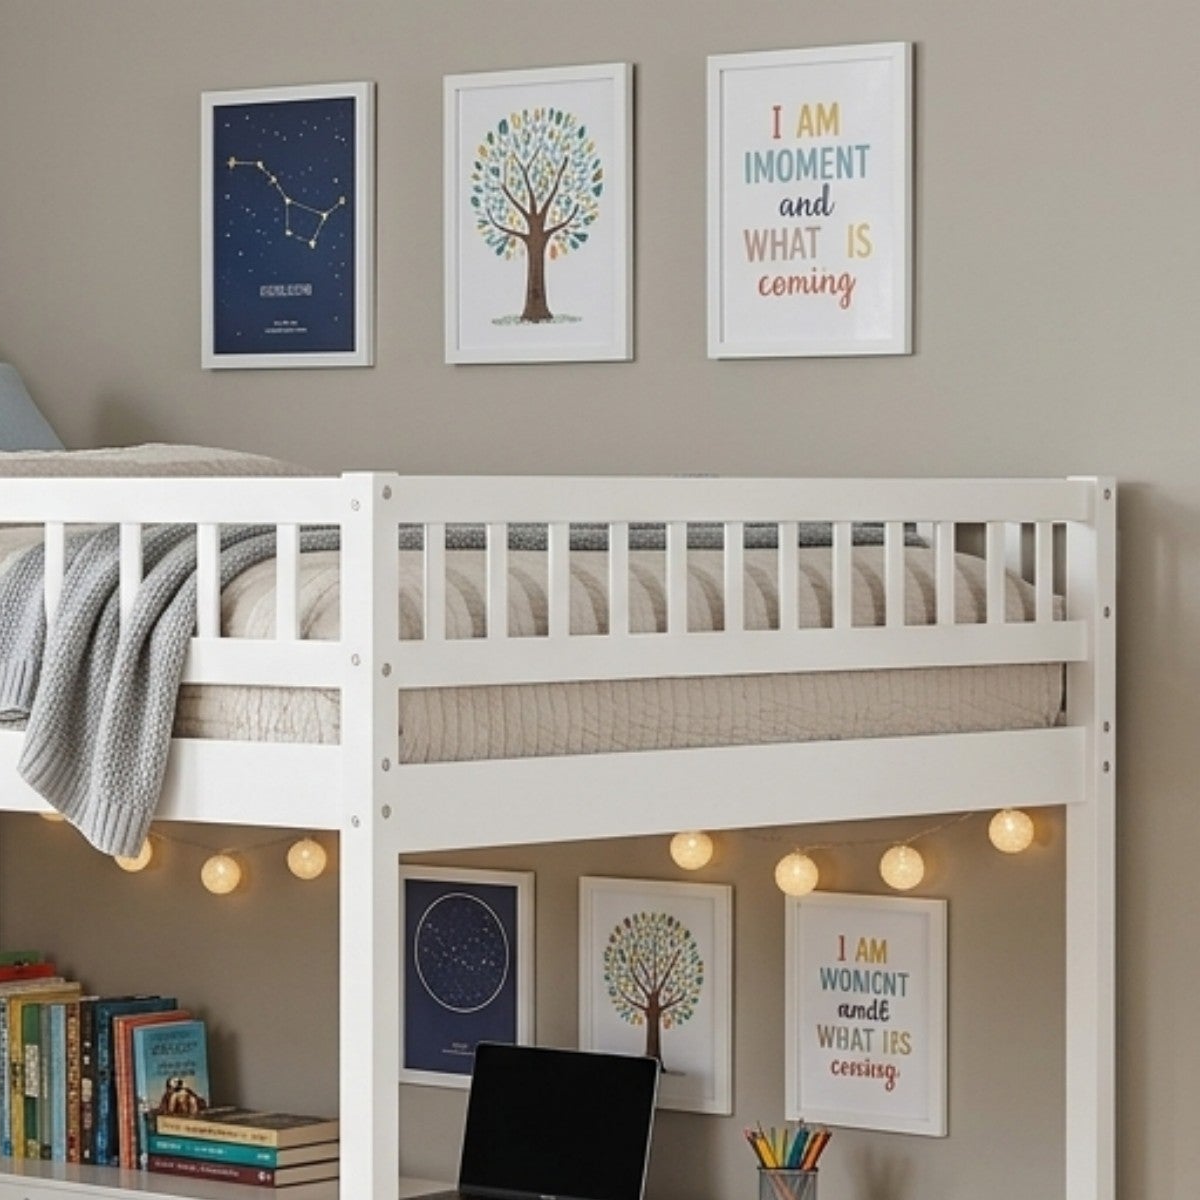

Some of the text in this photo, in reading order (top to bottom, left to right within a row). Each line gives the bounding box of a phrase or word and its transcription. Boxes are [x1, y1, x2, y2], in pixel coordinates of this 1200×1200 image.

[773, 102, 840, 139] I AM
[745, 144, 870, 184] IMOMENT
[779, 183, 835, 217] and
[744, 223, 873, 262] WHAT IS
[758, 267, 856, 309] coming
[838, 935, 887, 963] I AM
